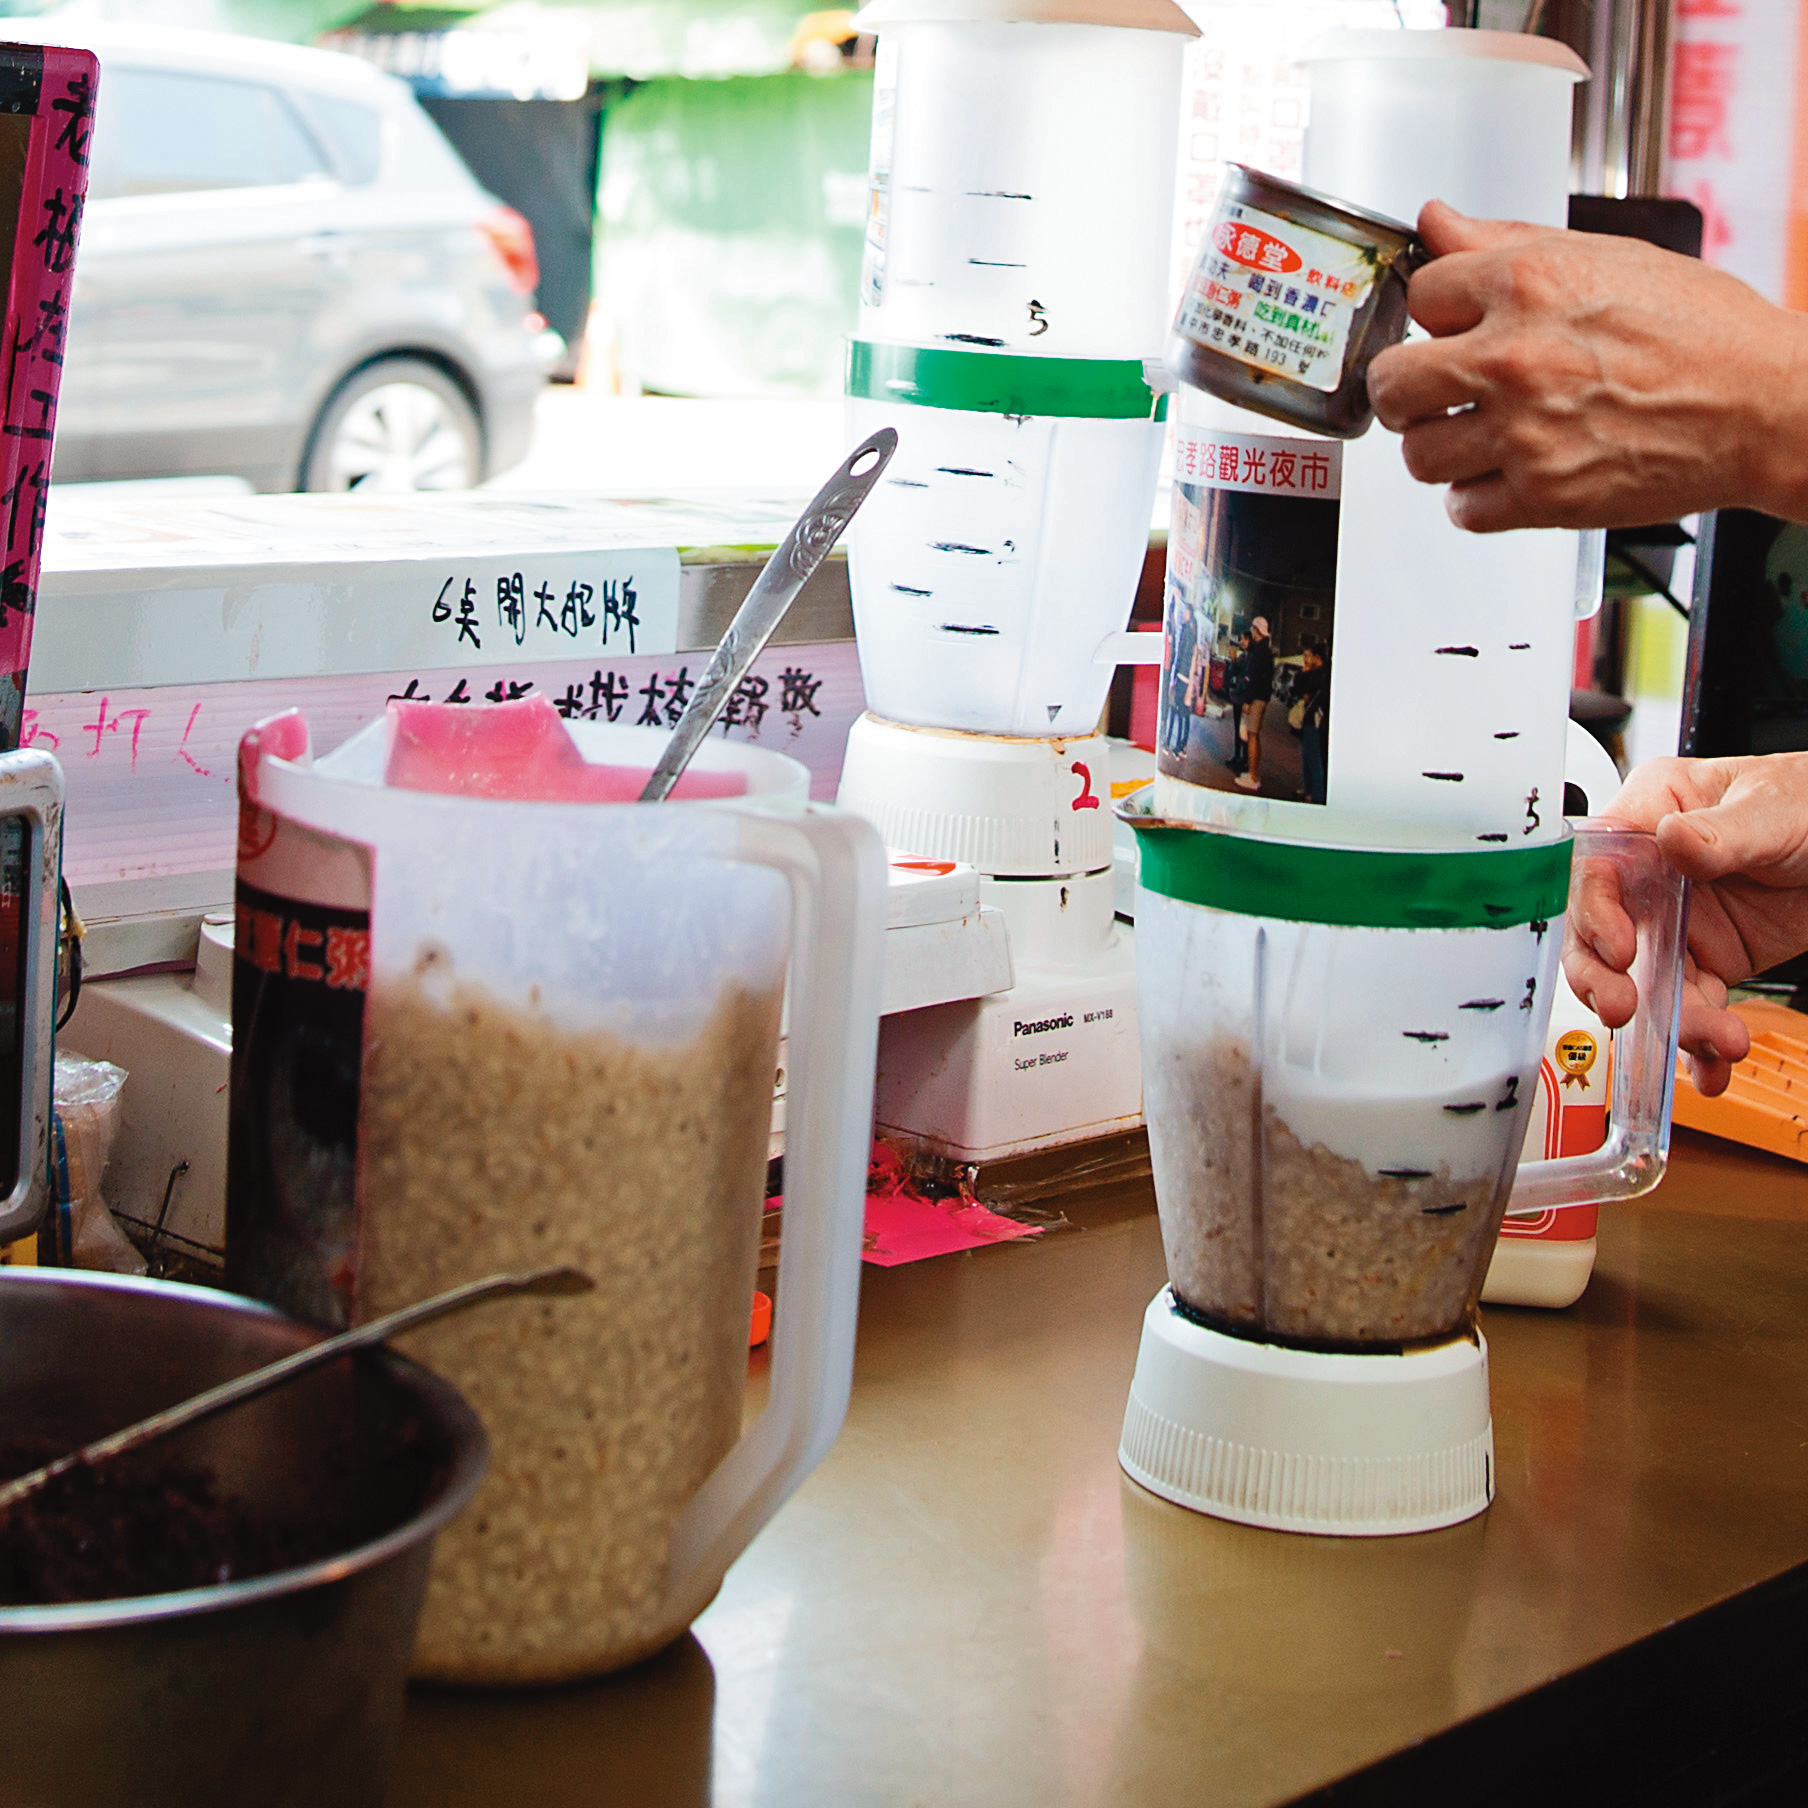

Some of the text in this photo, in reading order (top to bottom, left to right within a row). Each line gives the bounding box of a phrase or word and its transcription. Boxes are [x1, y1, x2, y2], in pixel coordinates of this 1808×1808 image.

[1264, 346, 1288, 368] 193
[1070, 761, 1100, 812] 2
[1013, 1012, 1074, 1037] Panasonic
[1014, 1049, 1069, 1071] Super Blender
